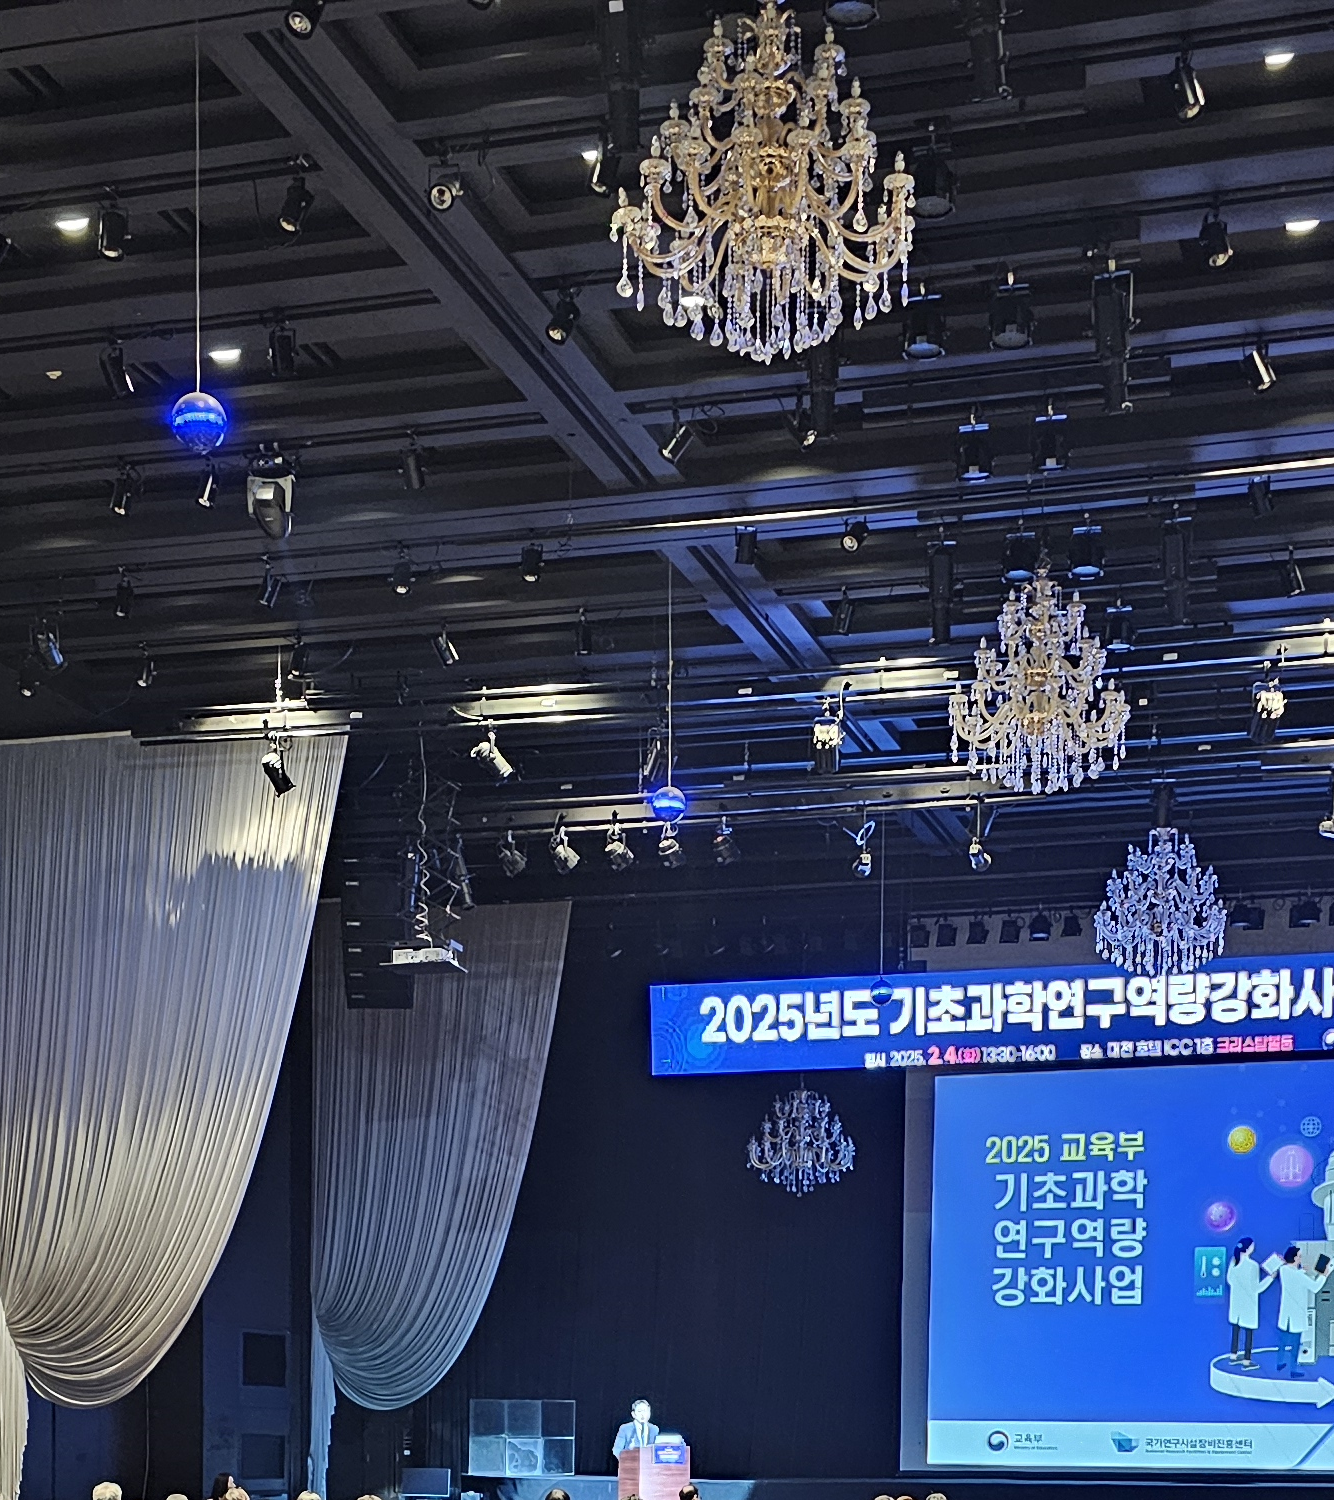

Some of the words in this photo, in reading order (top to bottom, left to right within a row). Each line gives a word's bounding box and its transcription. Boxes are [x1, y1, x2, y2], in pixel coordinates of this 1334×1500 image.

[699, 989, 881, 1044] 2025년도
[1107, 1040, 1134, 1058] 대전
[985, 1134, 1051, 1164] 2025
[1059, 1130, 1145, 1162] 교육부
[994, 1168, 1149, 1212] 기초과학
[994, 1216, 1148, 1259] 연구역량
[991, 1264, 1144, 1307] 강화사업
[1013, 1433, 1043, 1444] 교육부
